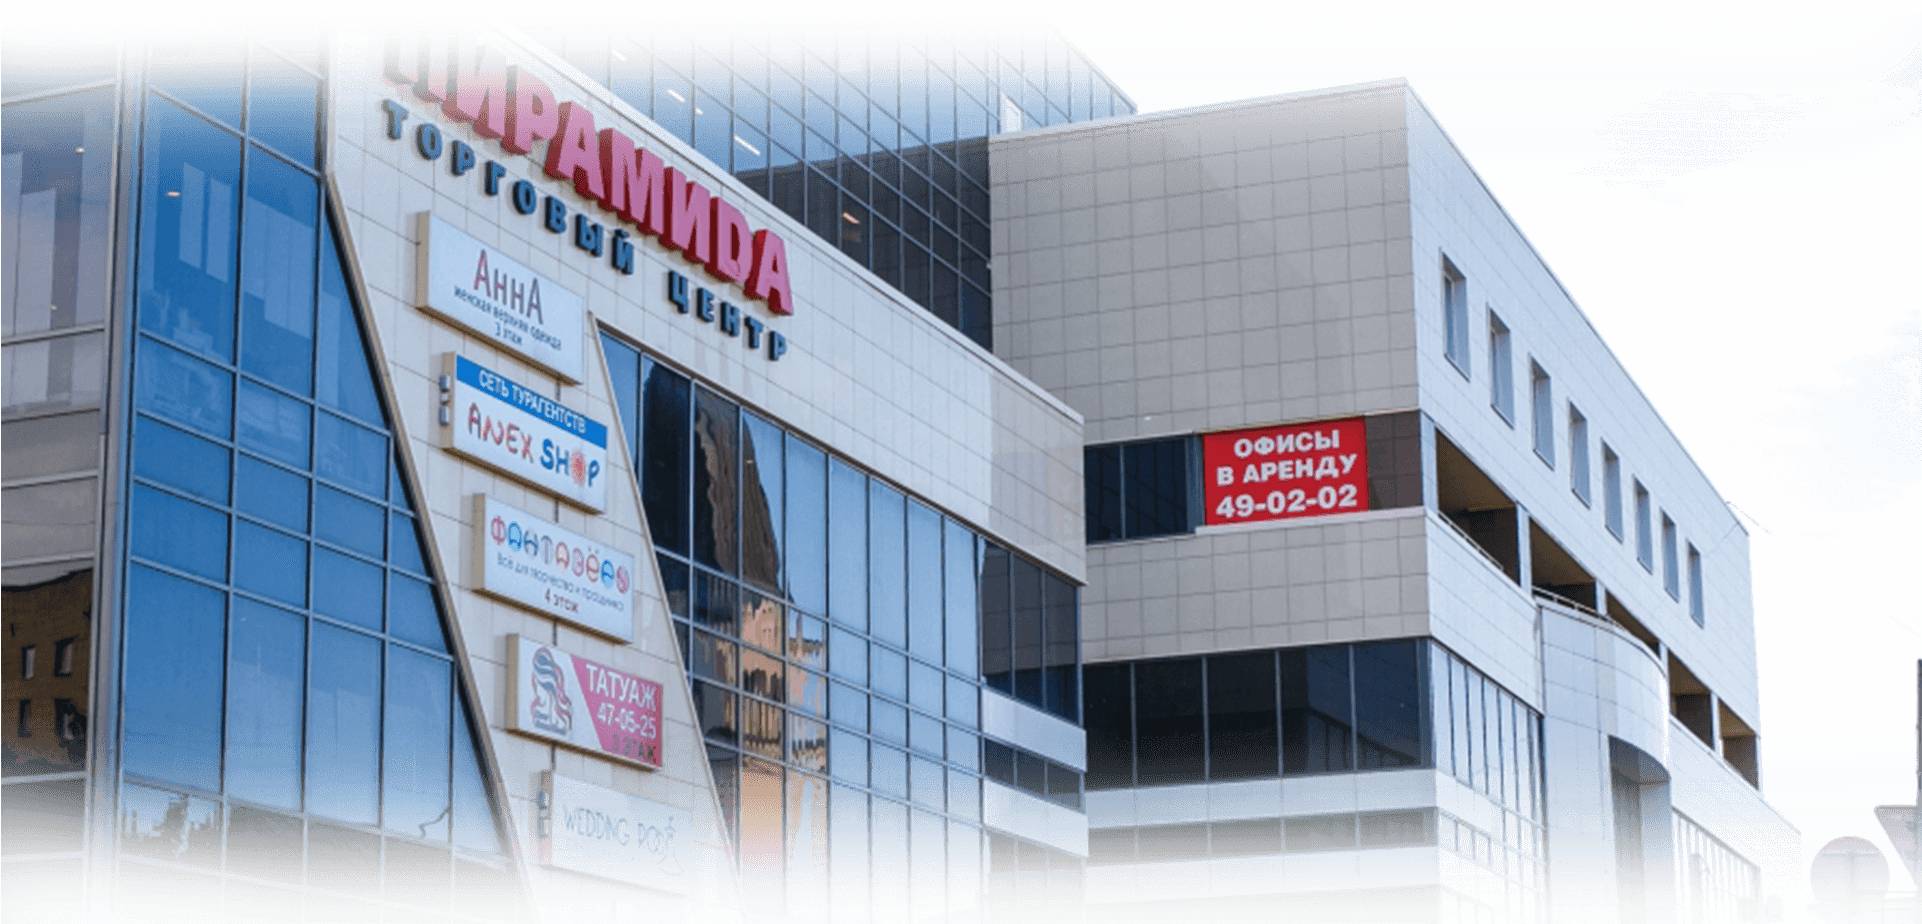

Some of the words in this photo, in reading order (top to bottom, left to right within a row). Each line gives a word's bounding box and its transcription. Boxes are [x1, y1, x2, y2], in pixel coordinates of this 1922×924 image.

[382, 99, 634, 274] ТОРГОВЫЙ
[668, 270, 787, 360] ЦЕНТР
[478, 369, 510, 398] СЕТЬ
[512, 384, 587, 435] ТУРАГЕНТСТВ
[468, 402, 534, 464] ANEX
[539, 438, 600, 488] SHOP
[1233, 429, 1340, 459] ОФИСЫ
[1216, 465, 1234, 487] В
[1243, 453, 1358, 484] АРЕНДУ
[1216, 484, 1358, 519] 49-02-02
[545, 588, 551, 604] 4
[585, 663, 657, 712] ТАТУАЖ
[562, 804, 630, 847] WEDDING
